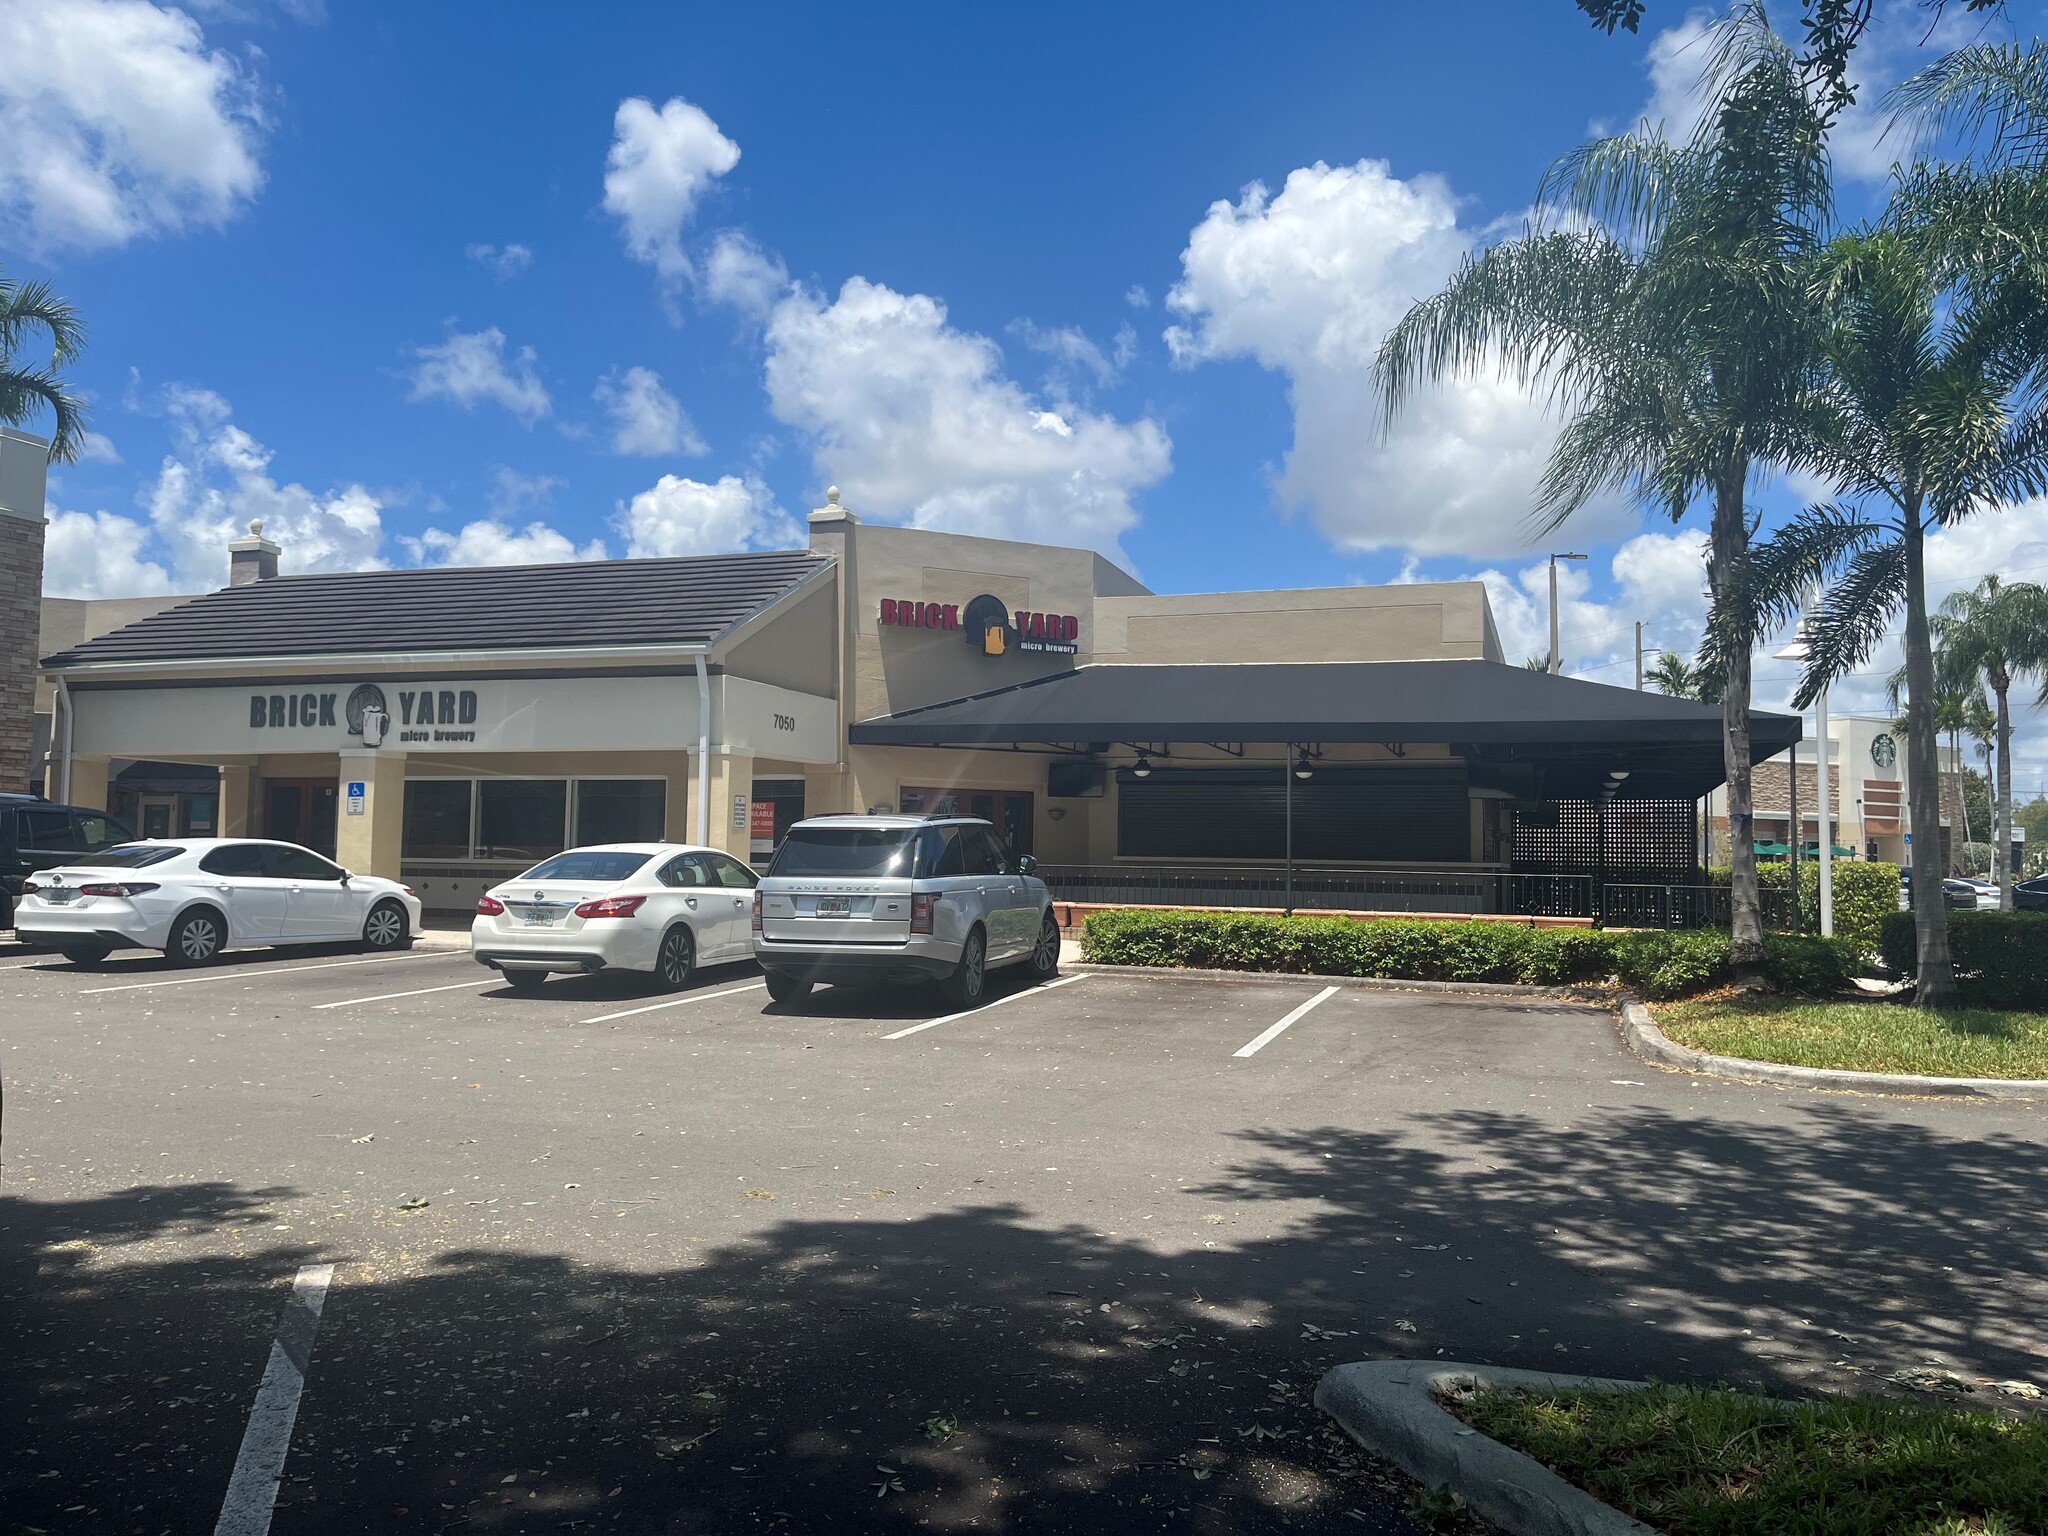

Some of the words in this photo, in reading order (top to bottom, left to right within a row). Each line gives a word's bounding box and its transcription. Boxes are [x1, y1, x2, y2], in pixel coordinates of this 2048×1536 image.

[881, 598, 959, 631] BRICK
[1014, 611, 1079, 641] YARD
[1020, 641, 1043, 651] micro
[1045, 643, 1075, 654] brewery
[250, 693, 336, 728] BRICK
[399, 690, 477, 725] YARD
[773, 714, 795, 732] 7050
[400, 731, 430, 742] micro
[434, 729, 475, 743] brewery
[752, 802, 767, 810] PACE
[751, 810, 773, 818] AILABLE
